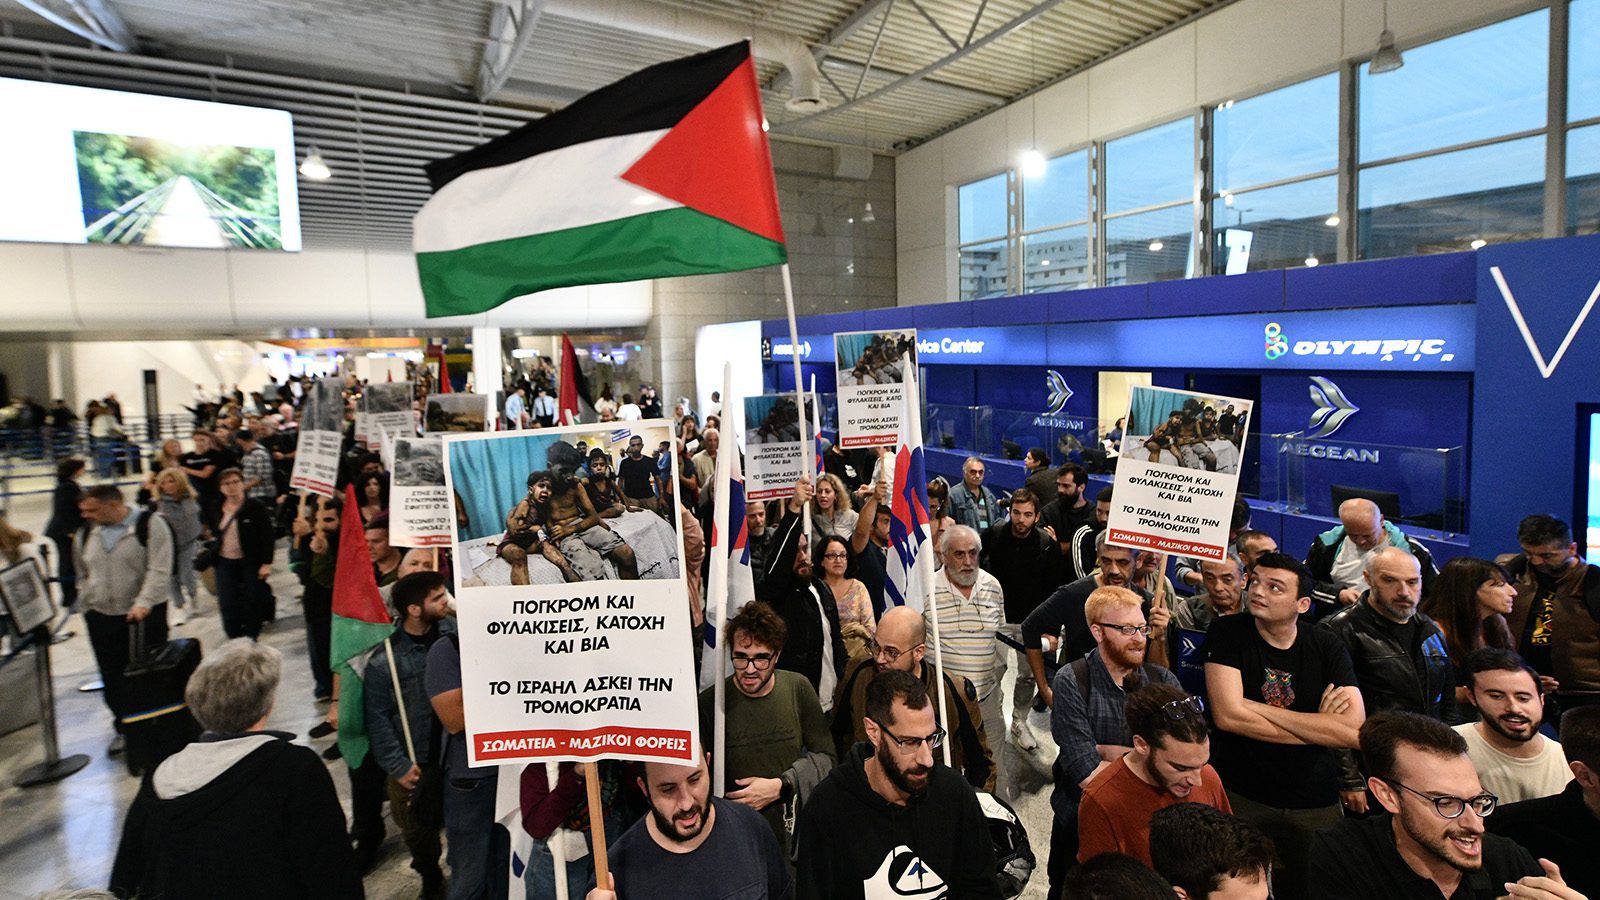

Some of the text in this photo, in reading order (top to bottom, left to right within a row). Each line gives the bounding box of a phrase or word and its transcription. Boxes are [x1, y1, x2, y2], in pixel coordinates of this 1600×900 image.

[941, 337, 984, 353] Center
[1293, 339, 1446, 355] OLYMPIC
[1031, 416, 1084, 430] AEGEAN
[1278, 442, 1380, 464] AEGEAN
[1145, 469, 1211, 485] ΠΟΓΚΡΟΜ ΚΑΙ
[1129, 477, 1224, 498] ΦΥΛΑΚΙΣΕΙΣ, ΚΑΤΟΧΗ
[1157, 491, 1192, 503] ΚΑΙ ΒΙΑ
[1122, 505, 1220, 527] ΤΟ ΙΣΡΑΗΛ ΑΣΚΕΙ ΤΗΝ
[1138, 518, 1200, 534] ΤΡΟΜΟΚΡΑΤΙΑ
[1112, 532, 1151, 544] ΣΩΜΑΤΕΙΑ
[1157, 540, 1191, 551] ΜΑΖΙΚΟΙ
[1191, 546, 1221, 556] ΦΟΡΕΙΣ
[513, 595, 634, 614] ΠΟΓΚΡΟΜ ΚΑΙ
[486, 615, 665, 635] ΦΥΛΑΚΙΣΕΙΣ, ΚΑΤΟΧΗ
[544, 636, 610, 654] ΚΑΙ ΒΙΑ
[489, 676, 673, 696] ΤΟ ΙΣΡΑΗΛ ΑΣΚΕΙ ΤΗΝ
[523, 696, 642, 715] ΤΡΟΜΟΚΡΑΤΙΑ
[481, 737, 556, 753] ΣΩΜΑΤΕΙΑ
[569, 734, 631, 750] ΜΑΖΙΚΟΙ
[634, 736, 687, 751] ΦΟΡΕΙΣ
